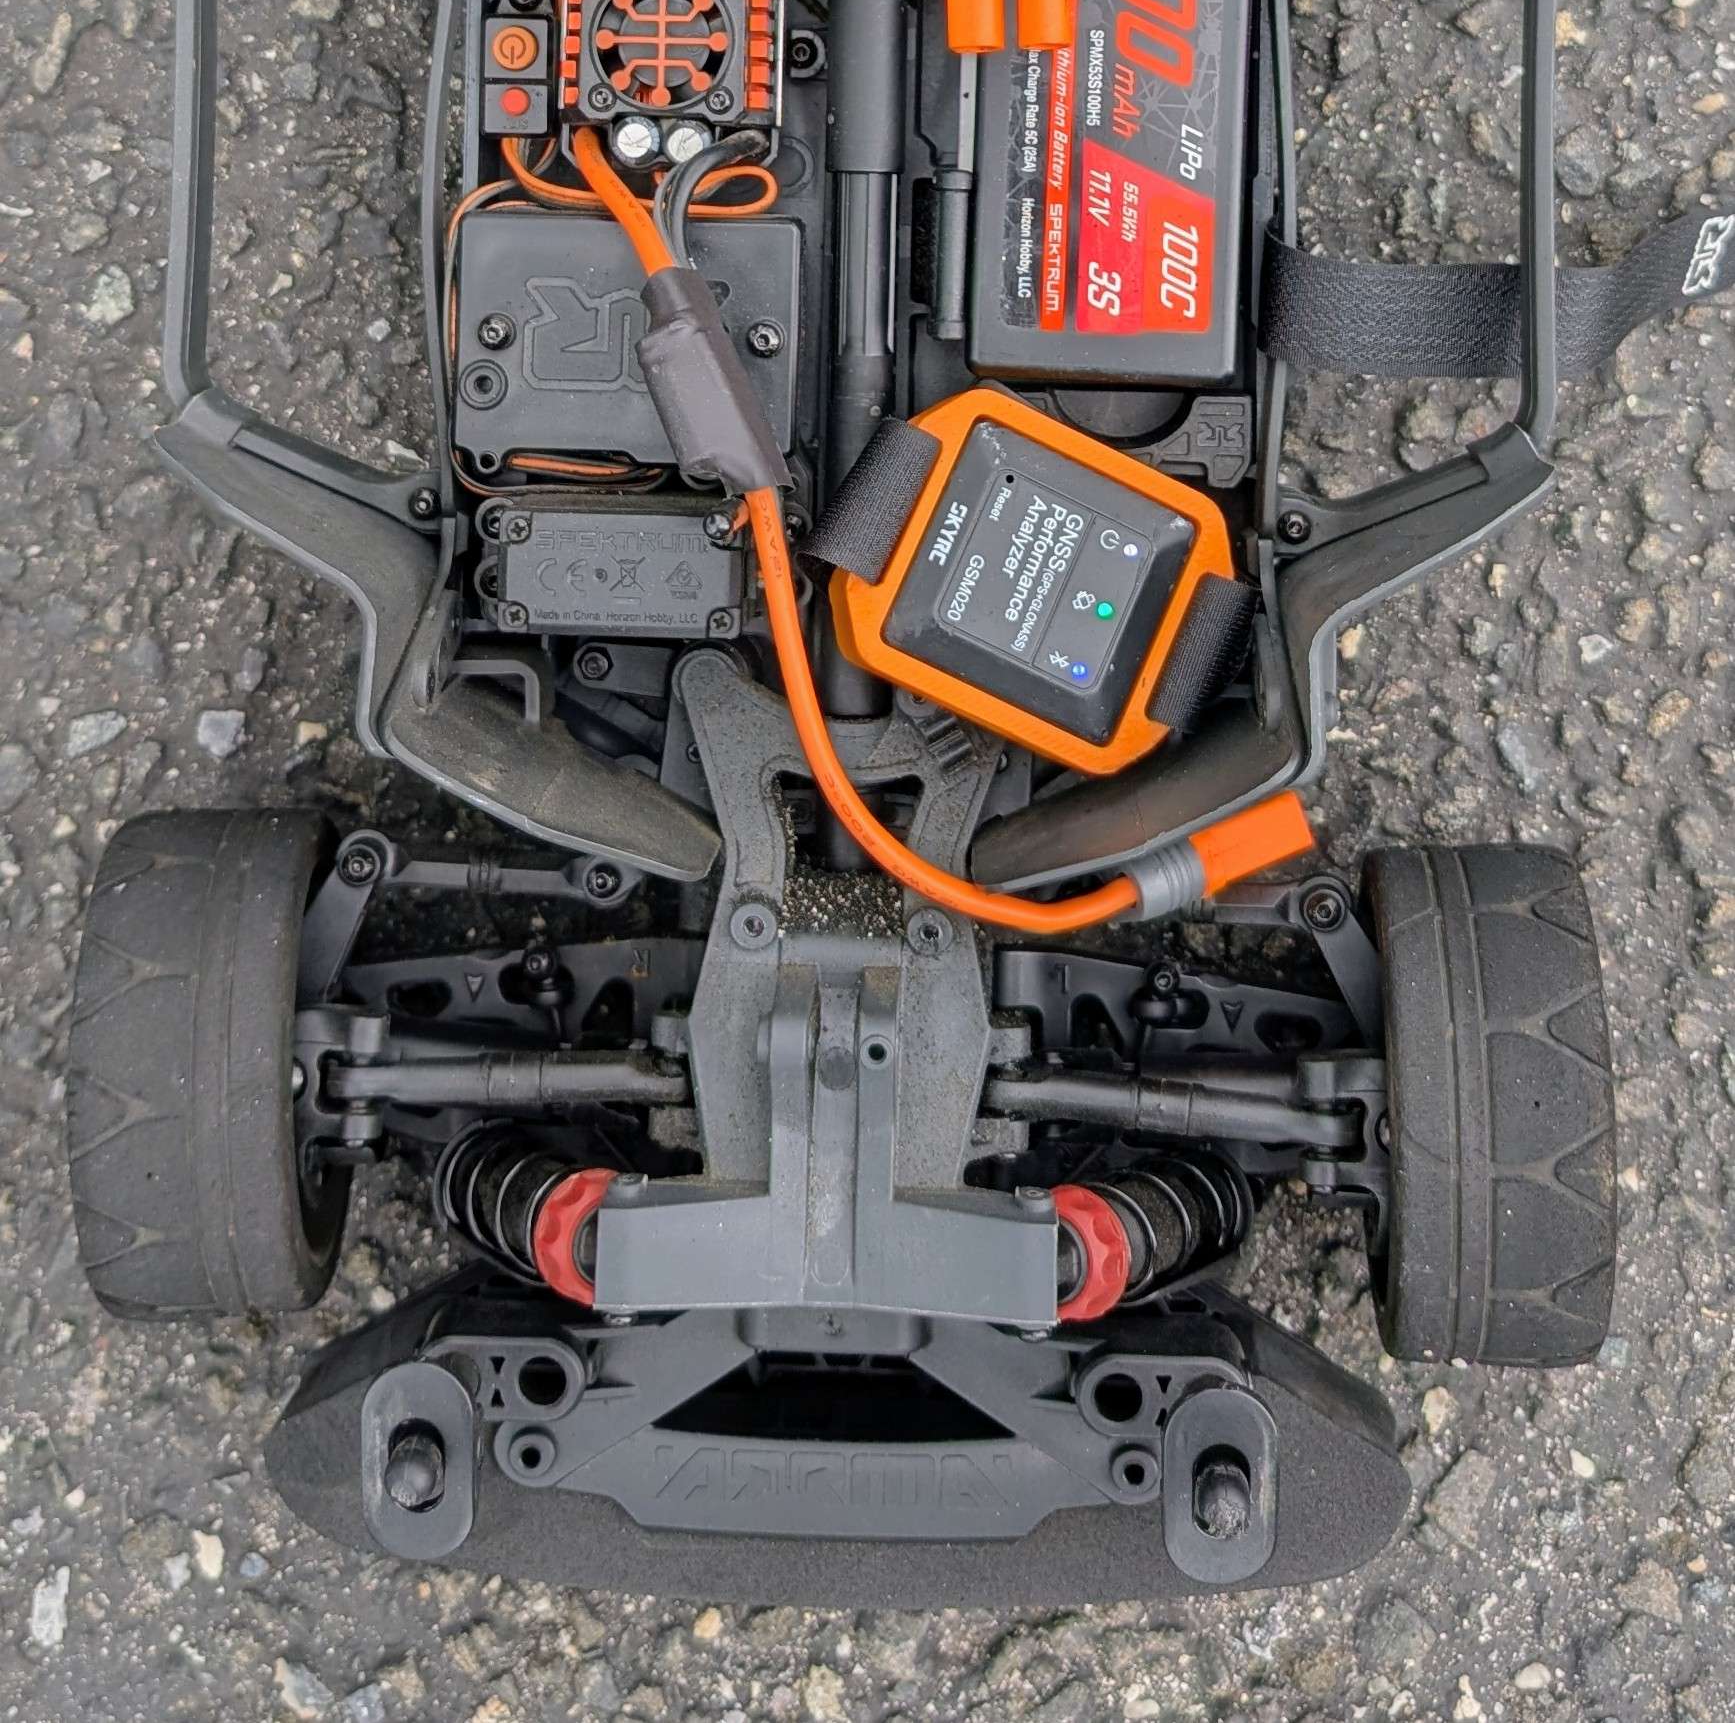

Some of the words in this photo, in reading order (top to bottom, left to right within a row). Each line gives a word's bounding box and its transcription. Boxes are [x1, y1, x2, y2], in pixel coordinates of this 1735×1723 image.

[1026, 65, 1041, 103] Charge
[1024, 130, 1038, 145] 5C
[1025, 104, 1040, 128] Rate
[1021, 146, 1038, 173] (25A)
[1049, 125, 1070, 192] Battery
[1179, 123, 1204, 181] LiPo
[1020, 197, 1035, 241] Horizon
[1088, 169, 1112, 227] 11.1V
[1120, 181, 1140, 243] 55.5Wh
[1016, 240, 1033, 275] Hobby,
[1018, 275, 1032, 298] LLC
[1045, 202, 1064, 313] SPEKTRUM
[1159, 219, 1200, 319] 100C
[1087, 261, 1123, 317] 3S
[988, 486, 1012, 521] Reset
[928, 501, 968, 566] SKYRC
[1002, 494, 1048, 579] Analyzer
[1004, 503, 1067, 621] Performance
[1048, 513, 1084, 572] GNSS
[947, 554, 985, 621] GSM020
[534, 610, 560, 620] Made
[606, 612, 642, 622] Horizon
[679, 613, 698, 624] LLC
